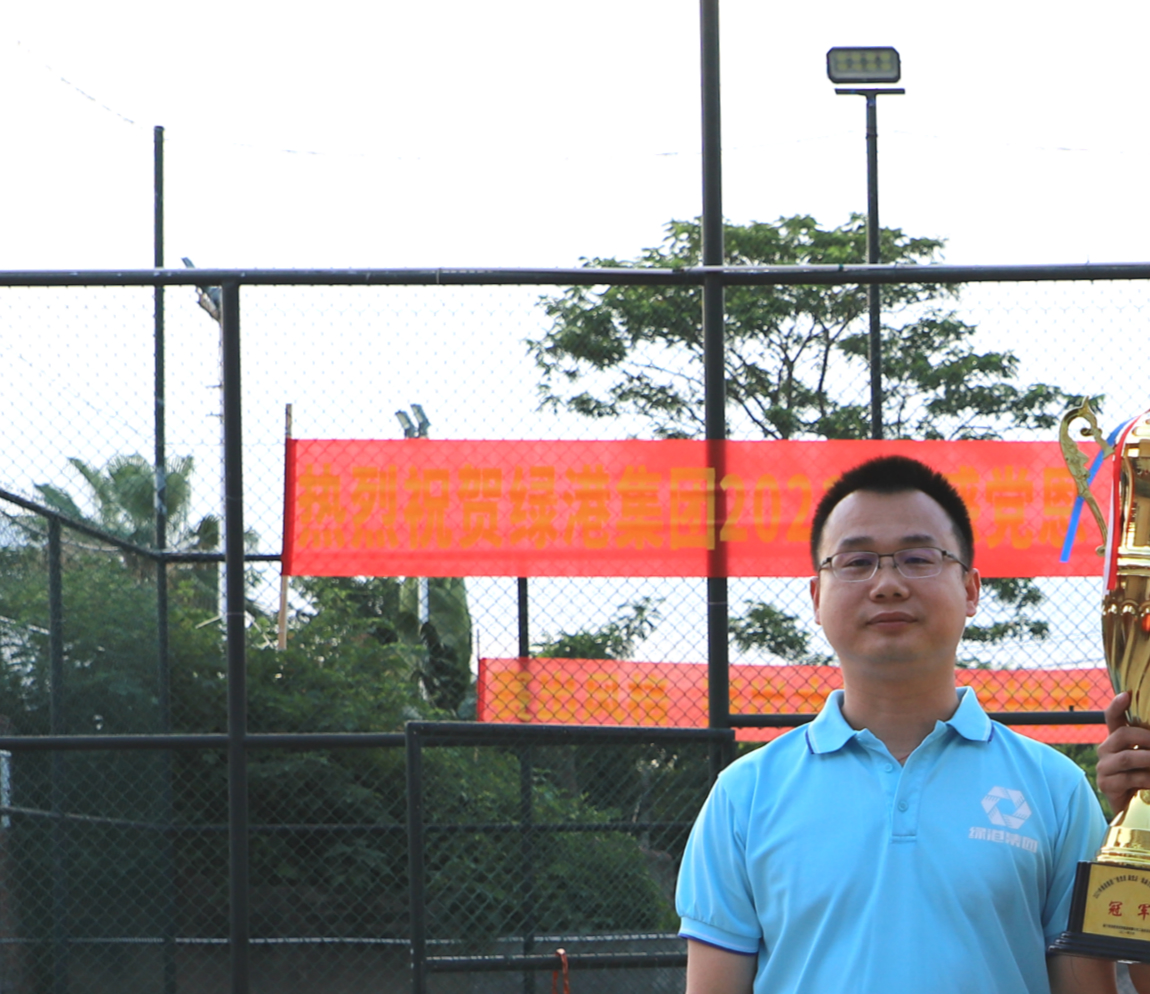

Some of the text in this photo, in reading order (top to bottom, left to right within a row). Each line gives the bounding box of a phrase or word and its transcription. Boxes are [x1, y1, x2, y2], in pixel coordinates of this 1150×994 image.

[297, 463, 852, 552] 热烈祝贺绿港集团202
